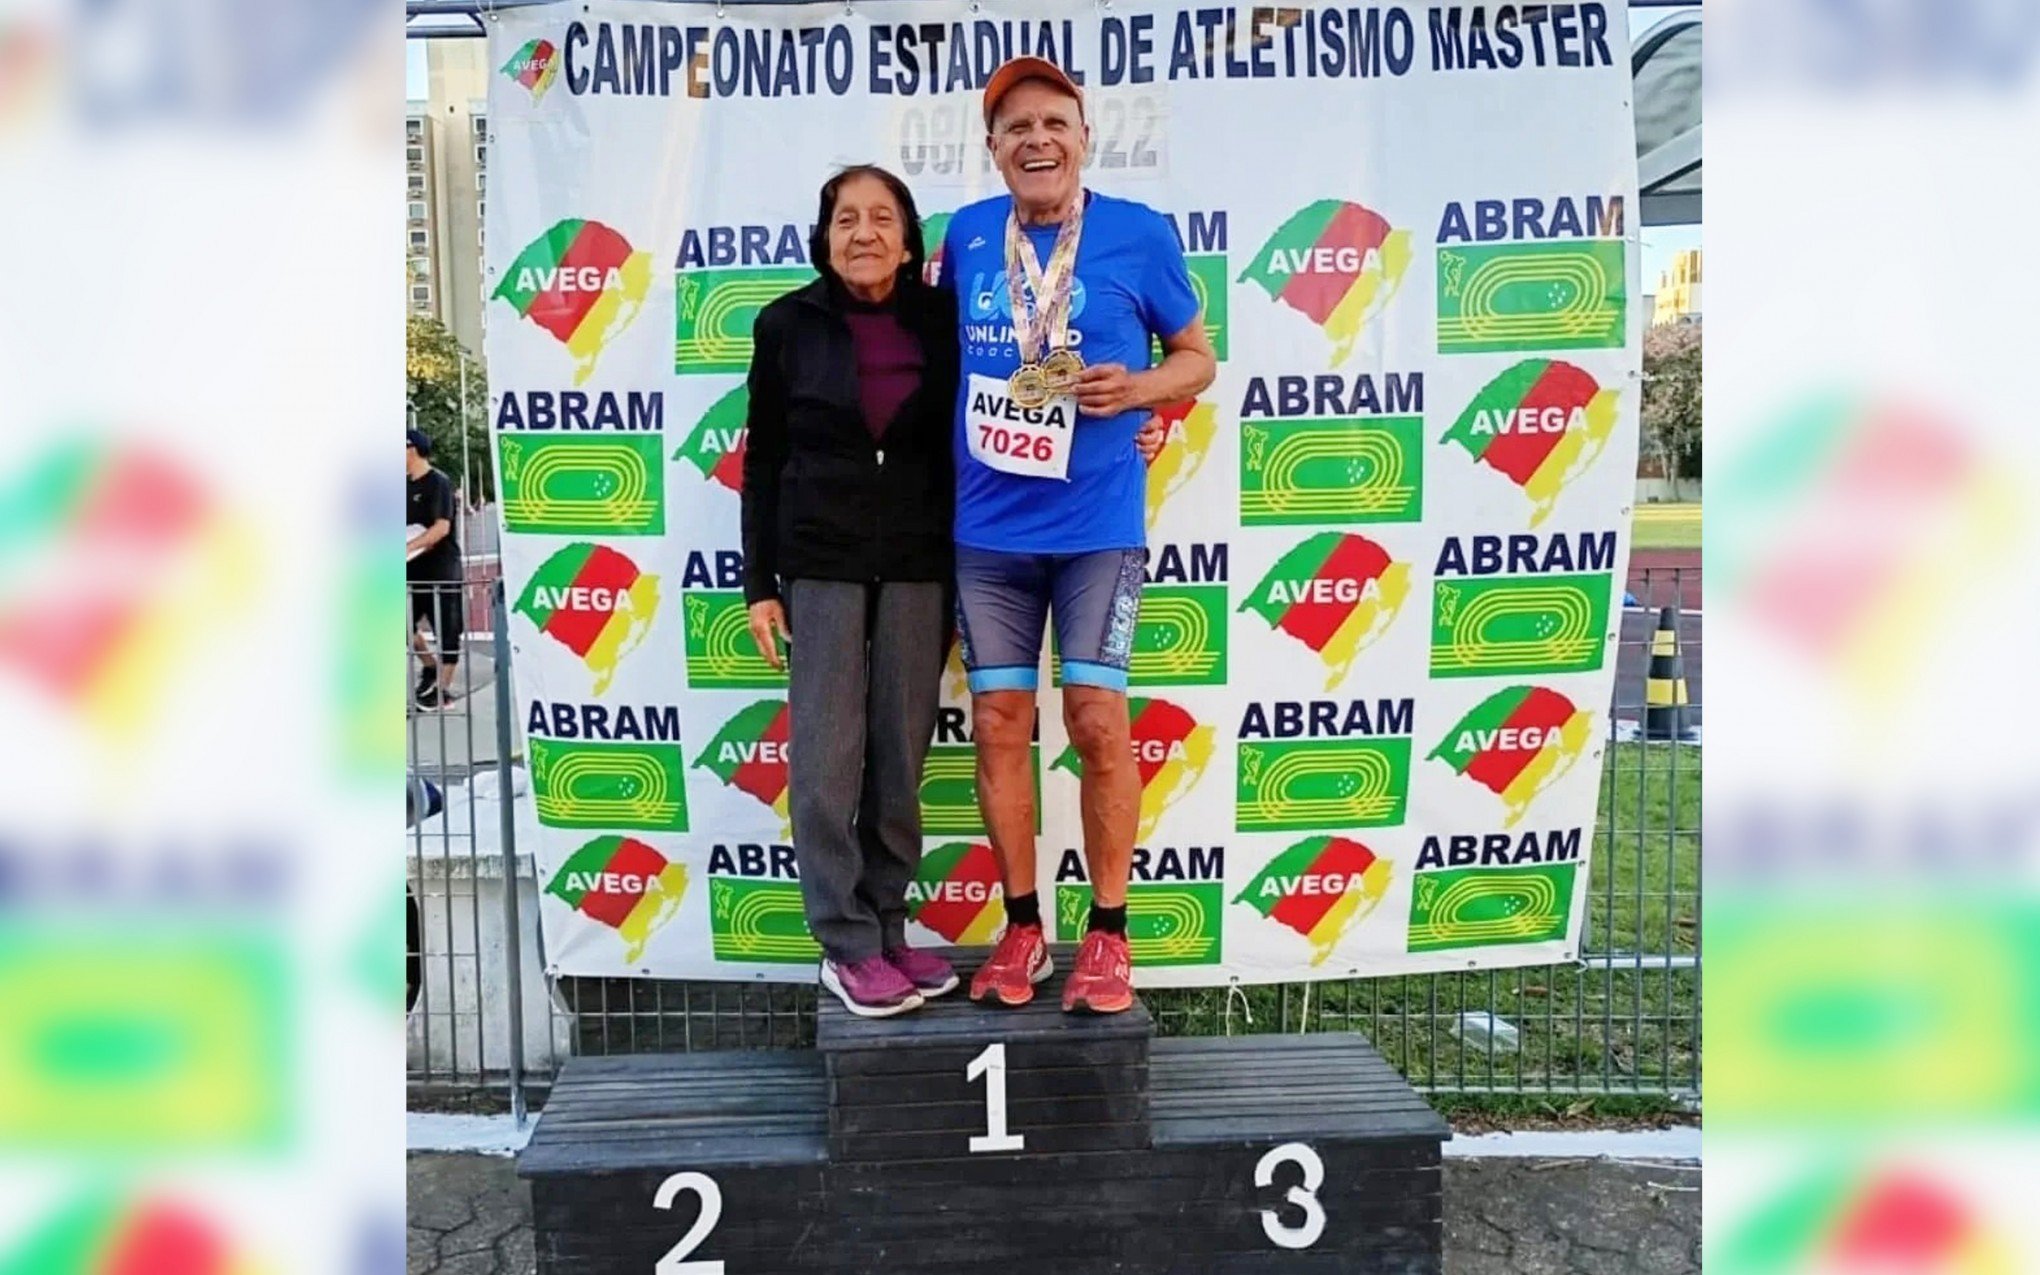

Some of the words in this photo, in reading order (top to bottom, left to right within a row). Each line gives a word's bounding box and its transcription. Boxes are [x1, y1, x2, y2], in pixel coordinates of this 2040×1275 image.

[564, 21, 853, 98] CAMPEONATO
[1101, 14, 1154, 86] DE
[1168, 6, 1414, 81] ATLETISMO
[1429, 2, 1613, 71] MASTER
[1436, 196, 1625, 244] ABRAM
[675, 225, 813, 268] ABRA
[1266, 246, 1383, 274] AVEGA
[516, 267, 625, 293] AVEGA
[496, 391, 664, 430] ABRAM
[973, 392, 1067, 428] AVEGA
[1240, 373, 1424, 418] ABRAM
[1469, 407, 1588, 435] AVEGA
[978, 425, 1053, 461] 7026
[1433, 531, 1617, 576] ABRAM
[532, 587, 635, 611] AVEGA
[1266, 579, 1380, 604] AVEGA
[527, 700, 680, 740] ABRAM
[1237, 698, 1415, 738] ABRAM
[717, 741, 789, 764] AVE
[1130, 739, 1188, 762] EGA
[1454, 726, 1563, 752] AVEGA
[708, 844, 799, 878] ABR
[1055, 847, 1224, 882] ARAM
[1415, 828, 1582, 867] ABRAM
[565, 871, 664, 893] AVEGA
[904, 881, 1004, 902] AVEGA
[1260, 874, 1364, 896] AVEGA
[966, 1043, 1025, 1152] 1
[1254, 1142, 1326, 1249] 3
[653, 1172, 725, 1275] 2
